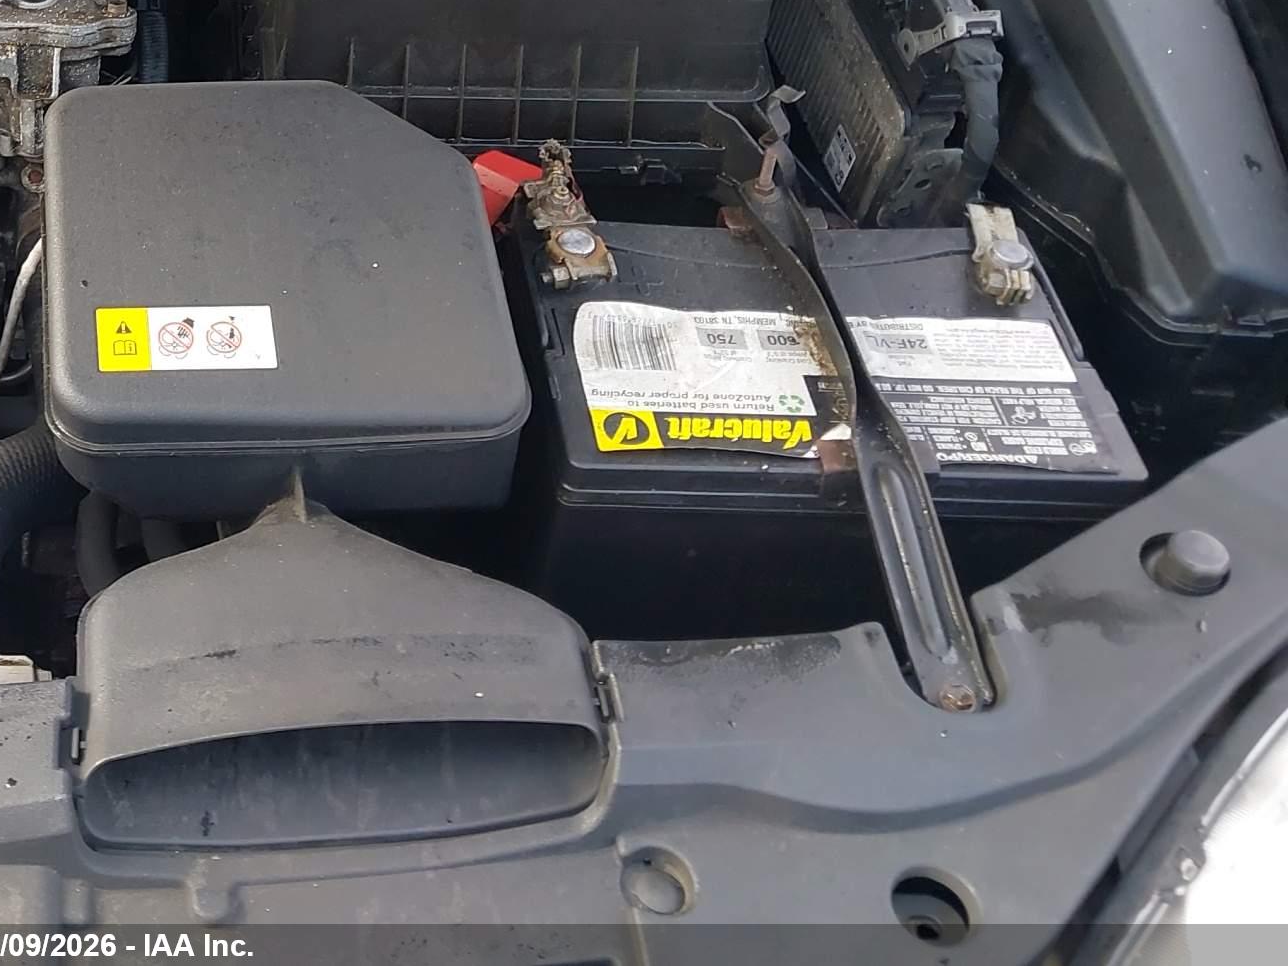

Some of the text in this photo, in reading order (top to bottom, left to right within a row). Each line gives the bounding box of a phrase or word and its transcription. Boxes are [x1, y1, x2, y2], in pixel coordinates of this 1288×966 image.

[721, 315, 733, 325] TN
[707, 333, 736, 345] 750
[767, 334, 797, 346] 600
[864, 333, 929, 350] 24F-VL
[590, 388, 772, 403] AutoZone for proper recycling
[643, 400, 697, 410] batteries
[700, 401, 730, 410] used
[732, 401, 775, 412] Return
[665, 416, 813, 450] Valucraft
